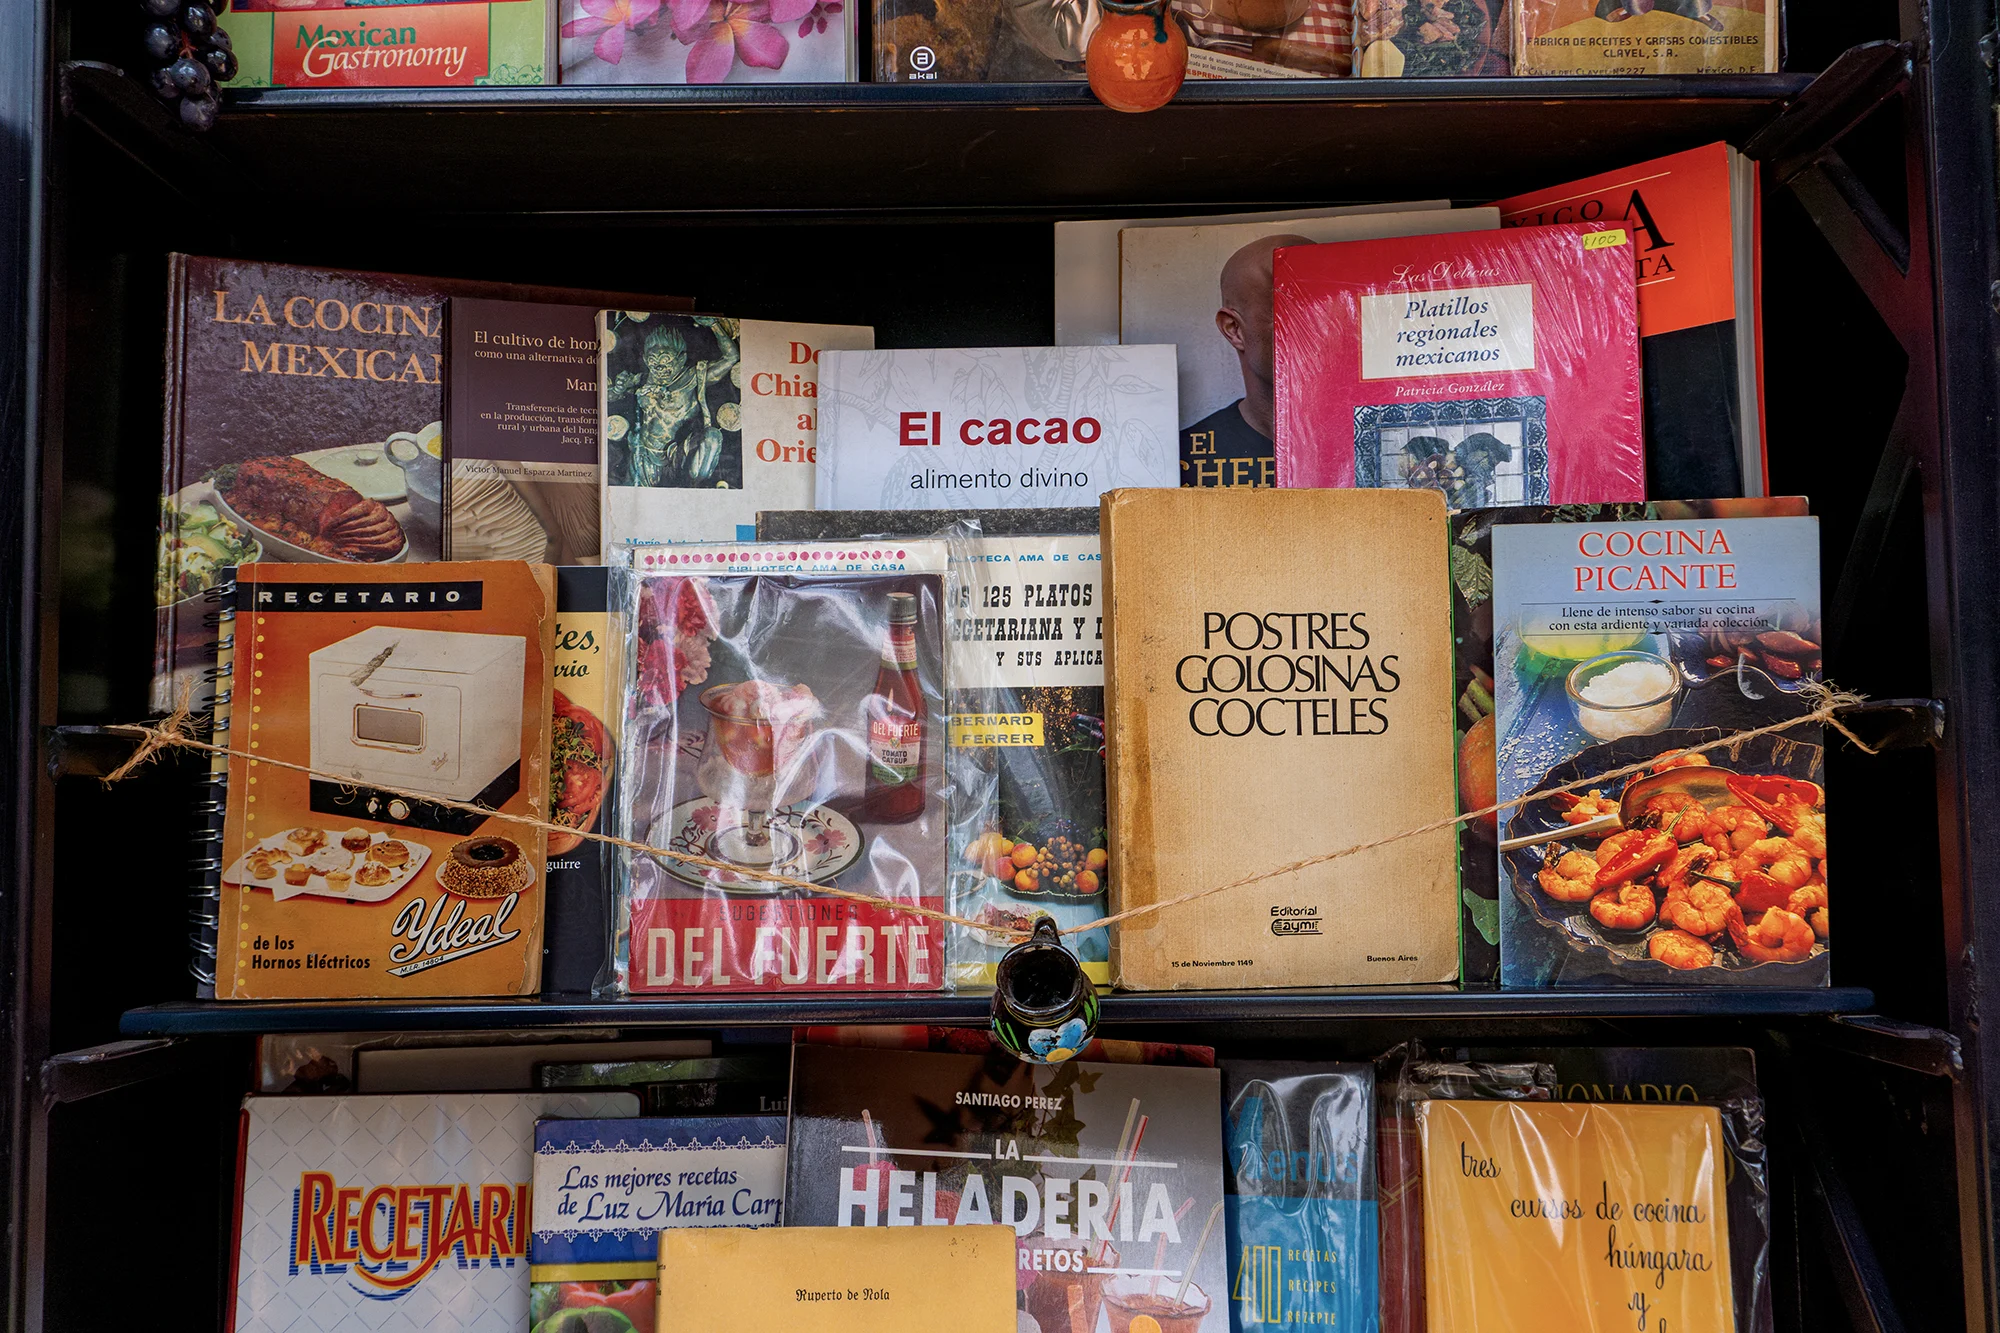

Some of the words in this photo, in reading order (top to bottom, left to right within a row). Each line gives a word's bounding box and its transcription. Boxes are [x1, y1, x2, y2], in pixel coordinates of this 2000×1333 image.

[295, 21, 416, 49] Mexican
[1573, 36, 1586, 46] DE
[1589, 36, 1632, 46] ACEITES
[1635, 36, 1642, 46] Y
[1645, 36, 1685, 46] GRASAS
[1688, 35, 1759, 45] COMESTIBLES
[302, 36, 467, 78] Gastronomy
[1603, 48, 1650, 59] CLAVEL,
[909, 71, 938, 80] akal
[1391, 264, 1425, 285] Las
[1430, 261, 1501, 282] Delicias
[212, 290, 276, 326] LA
[1404, 296, 1488, 319] Platillos
[474, 330, 488, 344] El
[492, 333, 543, 348] cultivo
[548, 336, 565, 349] de
[1396, 320, 1498, 347] regionales
[475, 349, 503, 360] como
[506, 351, 526, 361] una
[528, 351, 583, 364] alternativa
[1395, 348, 1501, 367] mexicanos
[566, 378, 597, 391] Man
[1395, 384, 1444, 397] Patricia
[1448, 380, 1505, 394] González
[480, 412, 491, 420] en
[493, 411, 502, 420] la
[504, 413, 555, 424] producción,
[506, 402, 565, 413] Transferencia
[567, 405, 578, 414] de
[497, 423, 520, 431] rural
[529, 424, 561, 433] urbana
[563, 425, 576, 434] del
[900, 412, 941, 446] El
[959, 416, 1101, 446] cacao
[561, 436, 582, 446] Jacq.
[584, 436, 595, 445] Fr.
[1190, 430, 1217, 455] El
[465, 465, 490, 474] Víctor
[493, 466, 522, 475] Manuel
[524, 468, 556, 477] Esparza
[557, 468, 593, 478] Martínez
[910, 468, 1011, 489] alimento
[1020, 467, 1089, 488] divino
[1578, 529, 1733, 558] COCINA
[811, 564, 838, 572] AMA
[846, 564, 862, 572] DE
[872, 563, 906, 571] CASA
[1019, 554, 1044, 562] AMA
[1053, 554, 1069, 562] DE
[1574, 564, 1737, 592] PICANTE
[258, 590, 461, 604] RECETARIO
[983, 586, 1011, 607] 125
[1024, 583, 1093, 607] PLATOS
[1562, 606, 1594, 618] Llene
[1597, 606, 1611, 617] de
[1615, 605, 1659, 617] intenso
[1661, 604, 1695, 617] sabor
[1698, 607, 1713, 616] su
[1716, 604, 1756, 615] cocina
[1073, 617, 1086, 640] Y
[1203, 611, 1370, 650] POSTRES
[1549, 621, 1570, 631] con
[1573, 620, 1598, 631] esta
[1600, 617, 1650, 631] ardiente
[1653, 620, 1661, 632] y
[1664, 618, 1709, 630] variada
[1712, 616, 1769, 629] colección
[996, 651, 1005, 666] Y
[1017, 651, 1042, 666] SUS
[1054, 650, 1103, 666] APLICA
[1175, 654, 1401, 693] GOLOSINAS
[950, 716, 1034, 727] BERNARD
[1189, 697, 1389, 737] COCTELES
[873, 721, 886, 736] DEL
[887, 723, 919, 737] FUERTE
[962, 734, 1034, 745] FERRER
[882, 749, 908, 757] TOMATO
[719, 904, 858, 922] SUGESTIONES
[1270, 905, 1317, 917] Editorial
[389, 892, 520, 963] Ydeal
[253, 935, 271, 951] de
[274, 935, 295, 951] los
[251, 954, 301, 969] Hornos
[306, 953, 371, 969] Eléctricos
[647, 927, 731, 987] DEL
[754, 925, 929, 986] FUERTE
[1181, 960, 1191, 968] de
[1192, 959, 1235, 968] Noviembre
[1237, 959, 1254, 967] 1149
[1366, 955, 1396, 963] Buenos
[955, 1090, 1021, 1109] SANTIAGO
[1025, 1095, 1063, 1111] PEREZ
[995, 1139, 1020, 1161] LA
[1460, 1140, 1501, 1179] tres
[558, 1166, 599, 1191] Las
[605, 1167, 671, 1195] mejores
[678, 1167, 737, 1186] recetas
[557, 1192, 577, 1216] de
[578, 1192, 630, 1223] Luz
[636, 1190, 725, 1221] María
[838, 1167, 1182, 1244] HELADERIA
[1510, 1197, 1586, 1220] cursos
[1595, 1181, 1623, 1221] de
[1633, 1198, 1706, 1224] cocina
[290, 1171, 533, 1290] RECETARI
[1018, 1249, 1084, 1273] RETOS
[1288, 1249, 1337, 1264] RECETAS
[1604, 1224, 1713, 1289] húngara
[1232, 1245, 1282, 1324] 400
[1288, 1279, 1337, 1294] RECIPES
[795, 1287, 843, 1304] Ruperto
[846, 1287, 859, 1302] de
[863, 1287, 890, 1302] Nola
[1287, 1310, 1337, 1326] REZEPTE
[1628, 1290, 1651, 1332] y
